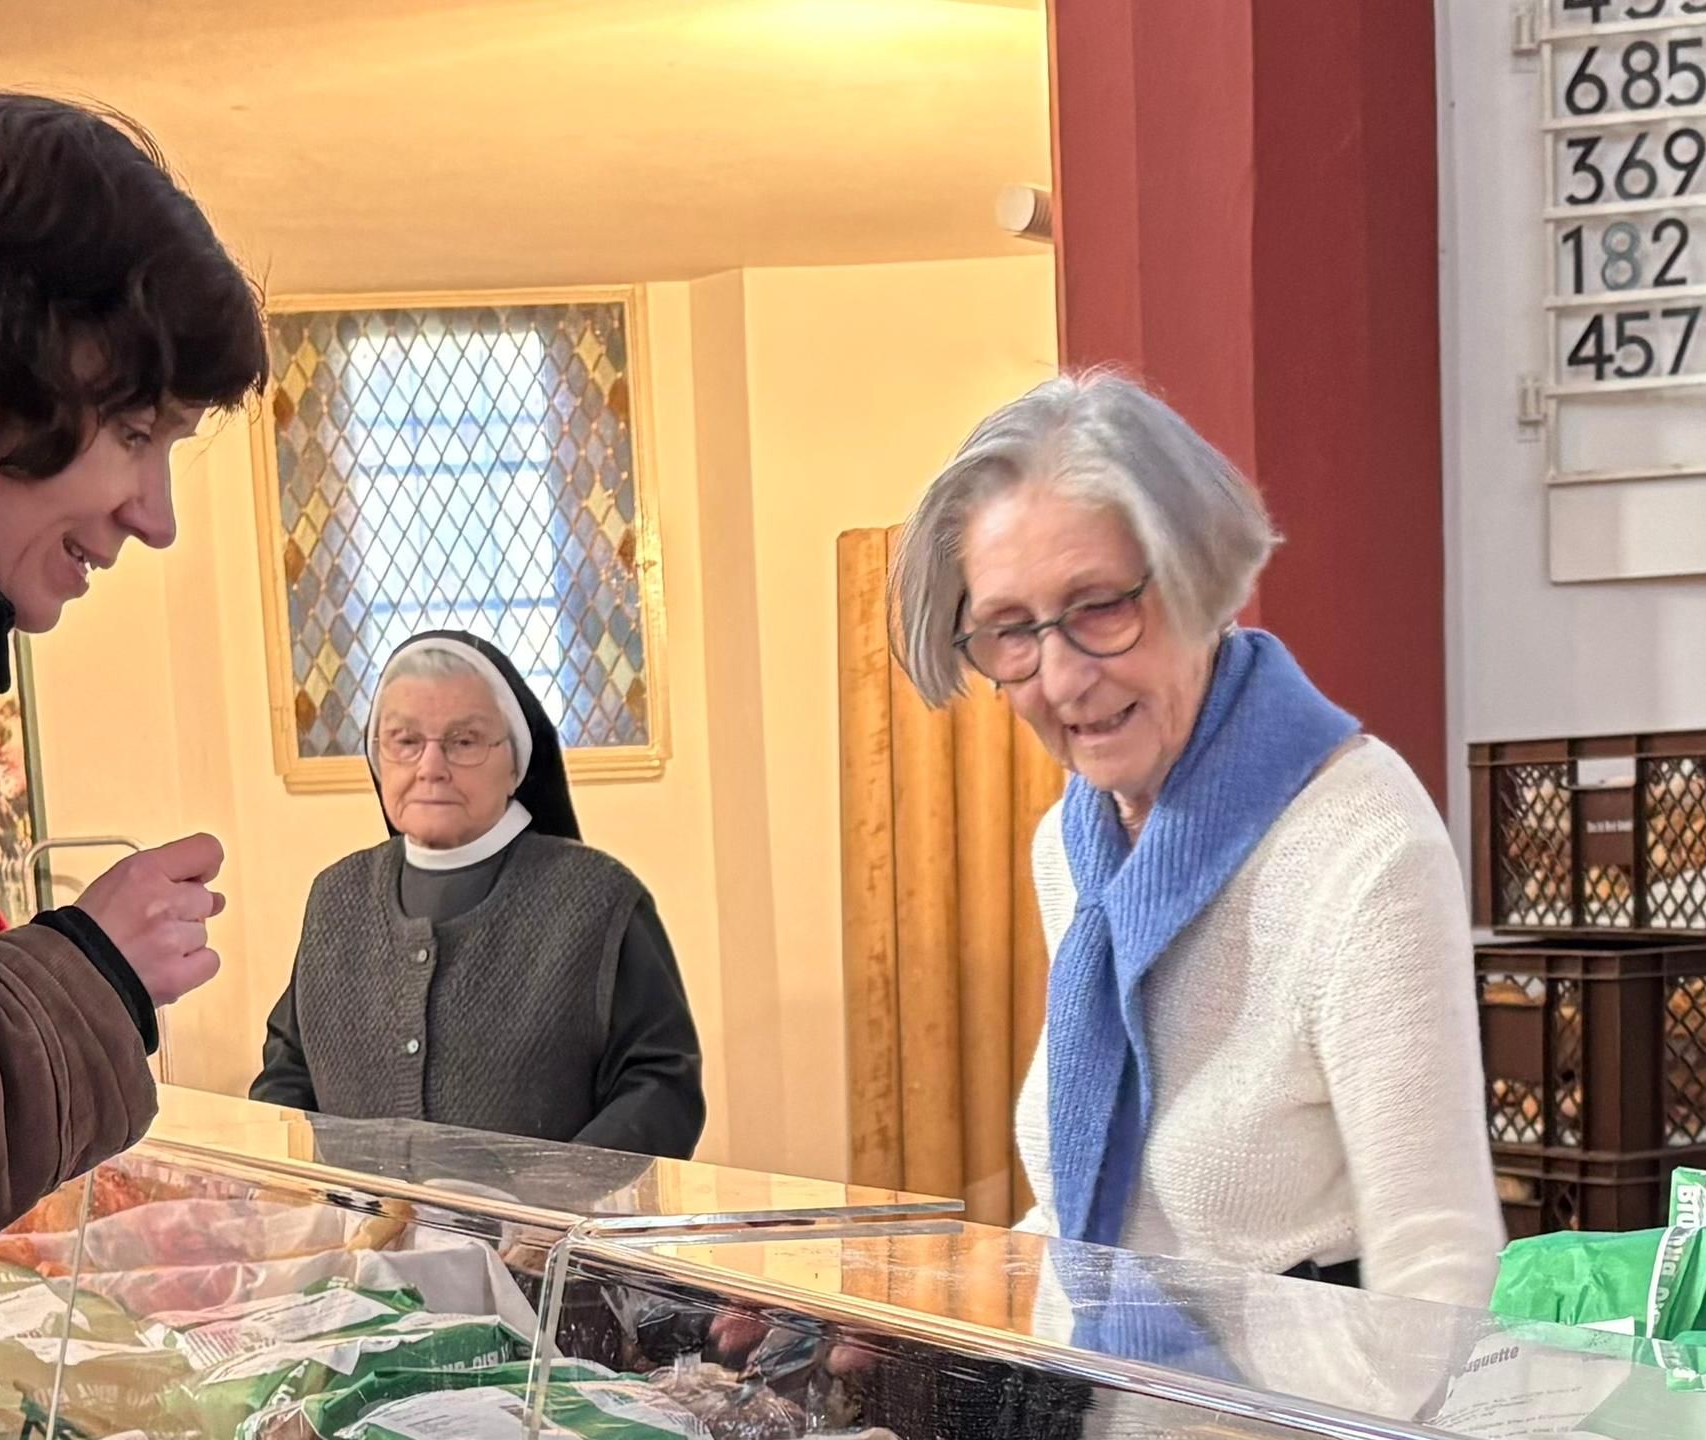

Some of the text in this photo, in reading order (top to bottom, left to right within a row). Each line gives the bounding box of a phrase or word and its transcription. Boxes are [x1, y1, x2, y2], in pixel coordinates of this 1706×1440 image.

[1563, 127, 1706, 206] 369
[1561, 217, 1690, 295] 182
[1566, 306, 1703, 381] 457
